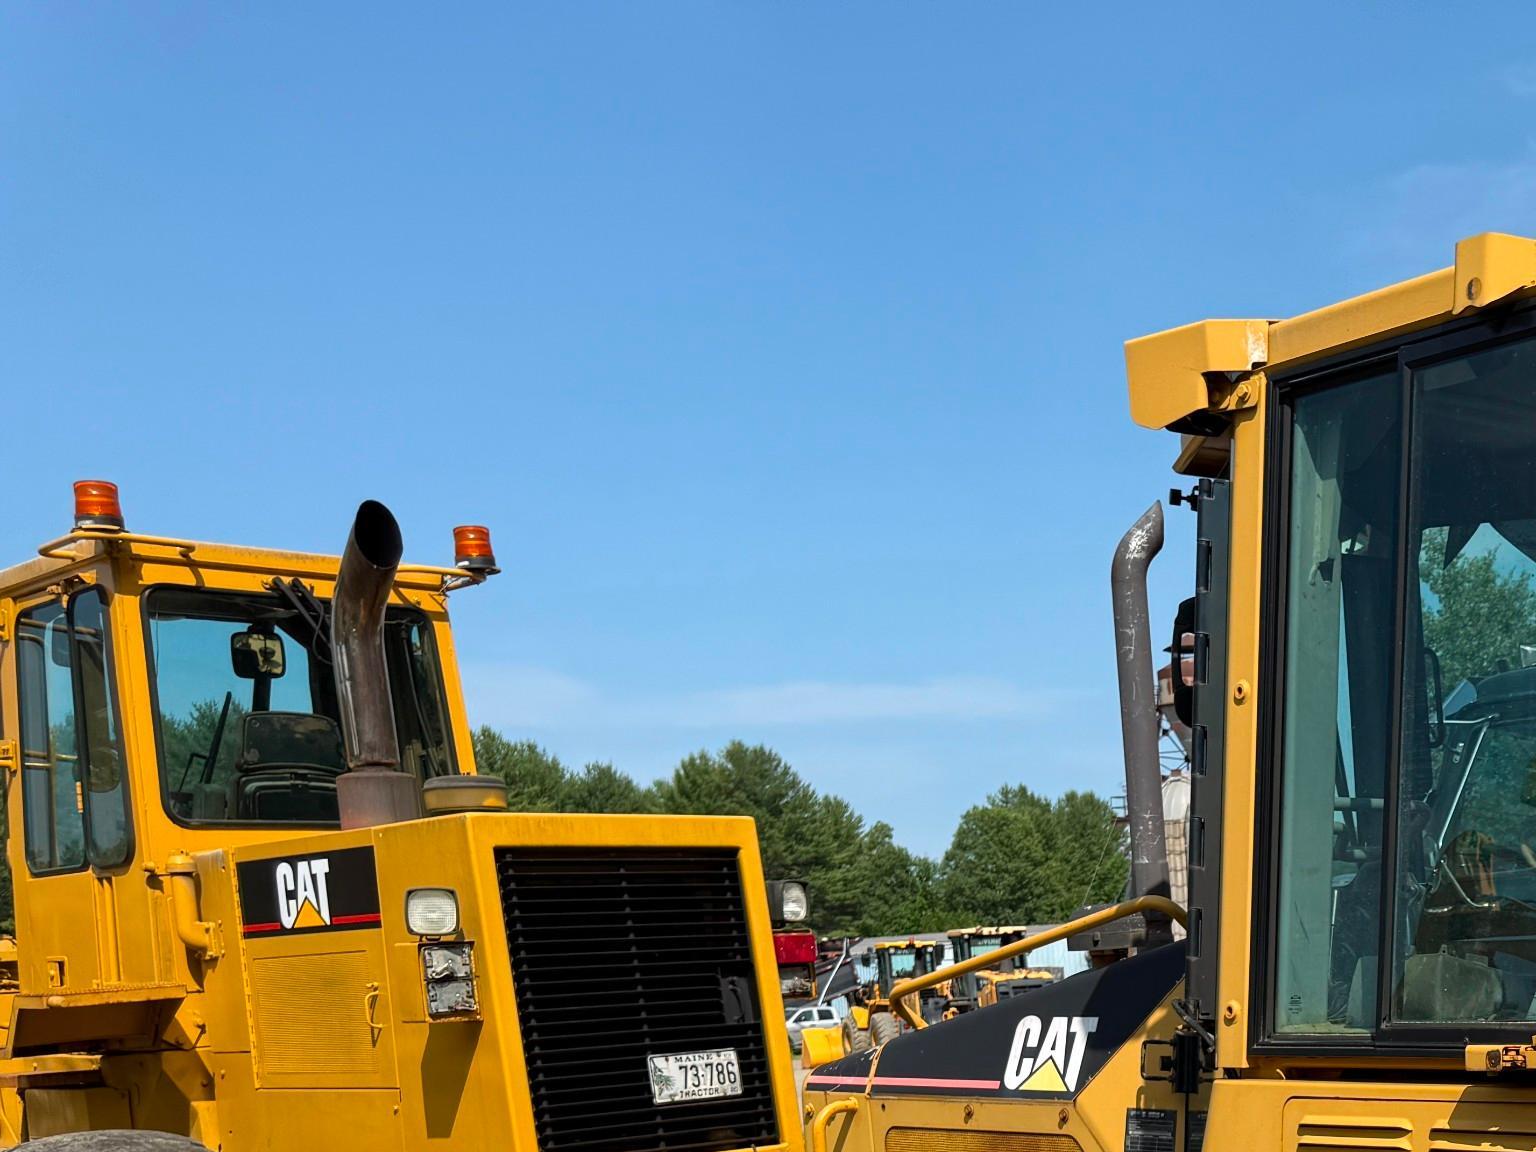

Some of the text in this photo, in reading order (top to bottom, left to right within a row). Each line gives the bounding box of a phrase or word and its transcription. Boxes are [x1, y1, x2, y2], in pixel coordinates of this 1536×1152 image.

[276, 858, 331, 929] CAT
[674, 1053, 713, 1063] MAINE
[1003, 1014, 1099, 1093] CAT
[680, 1087, 720, 1098] TRACTOR
